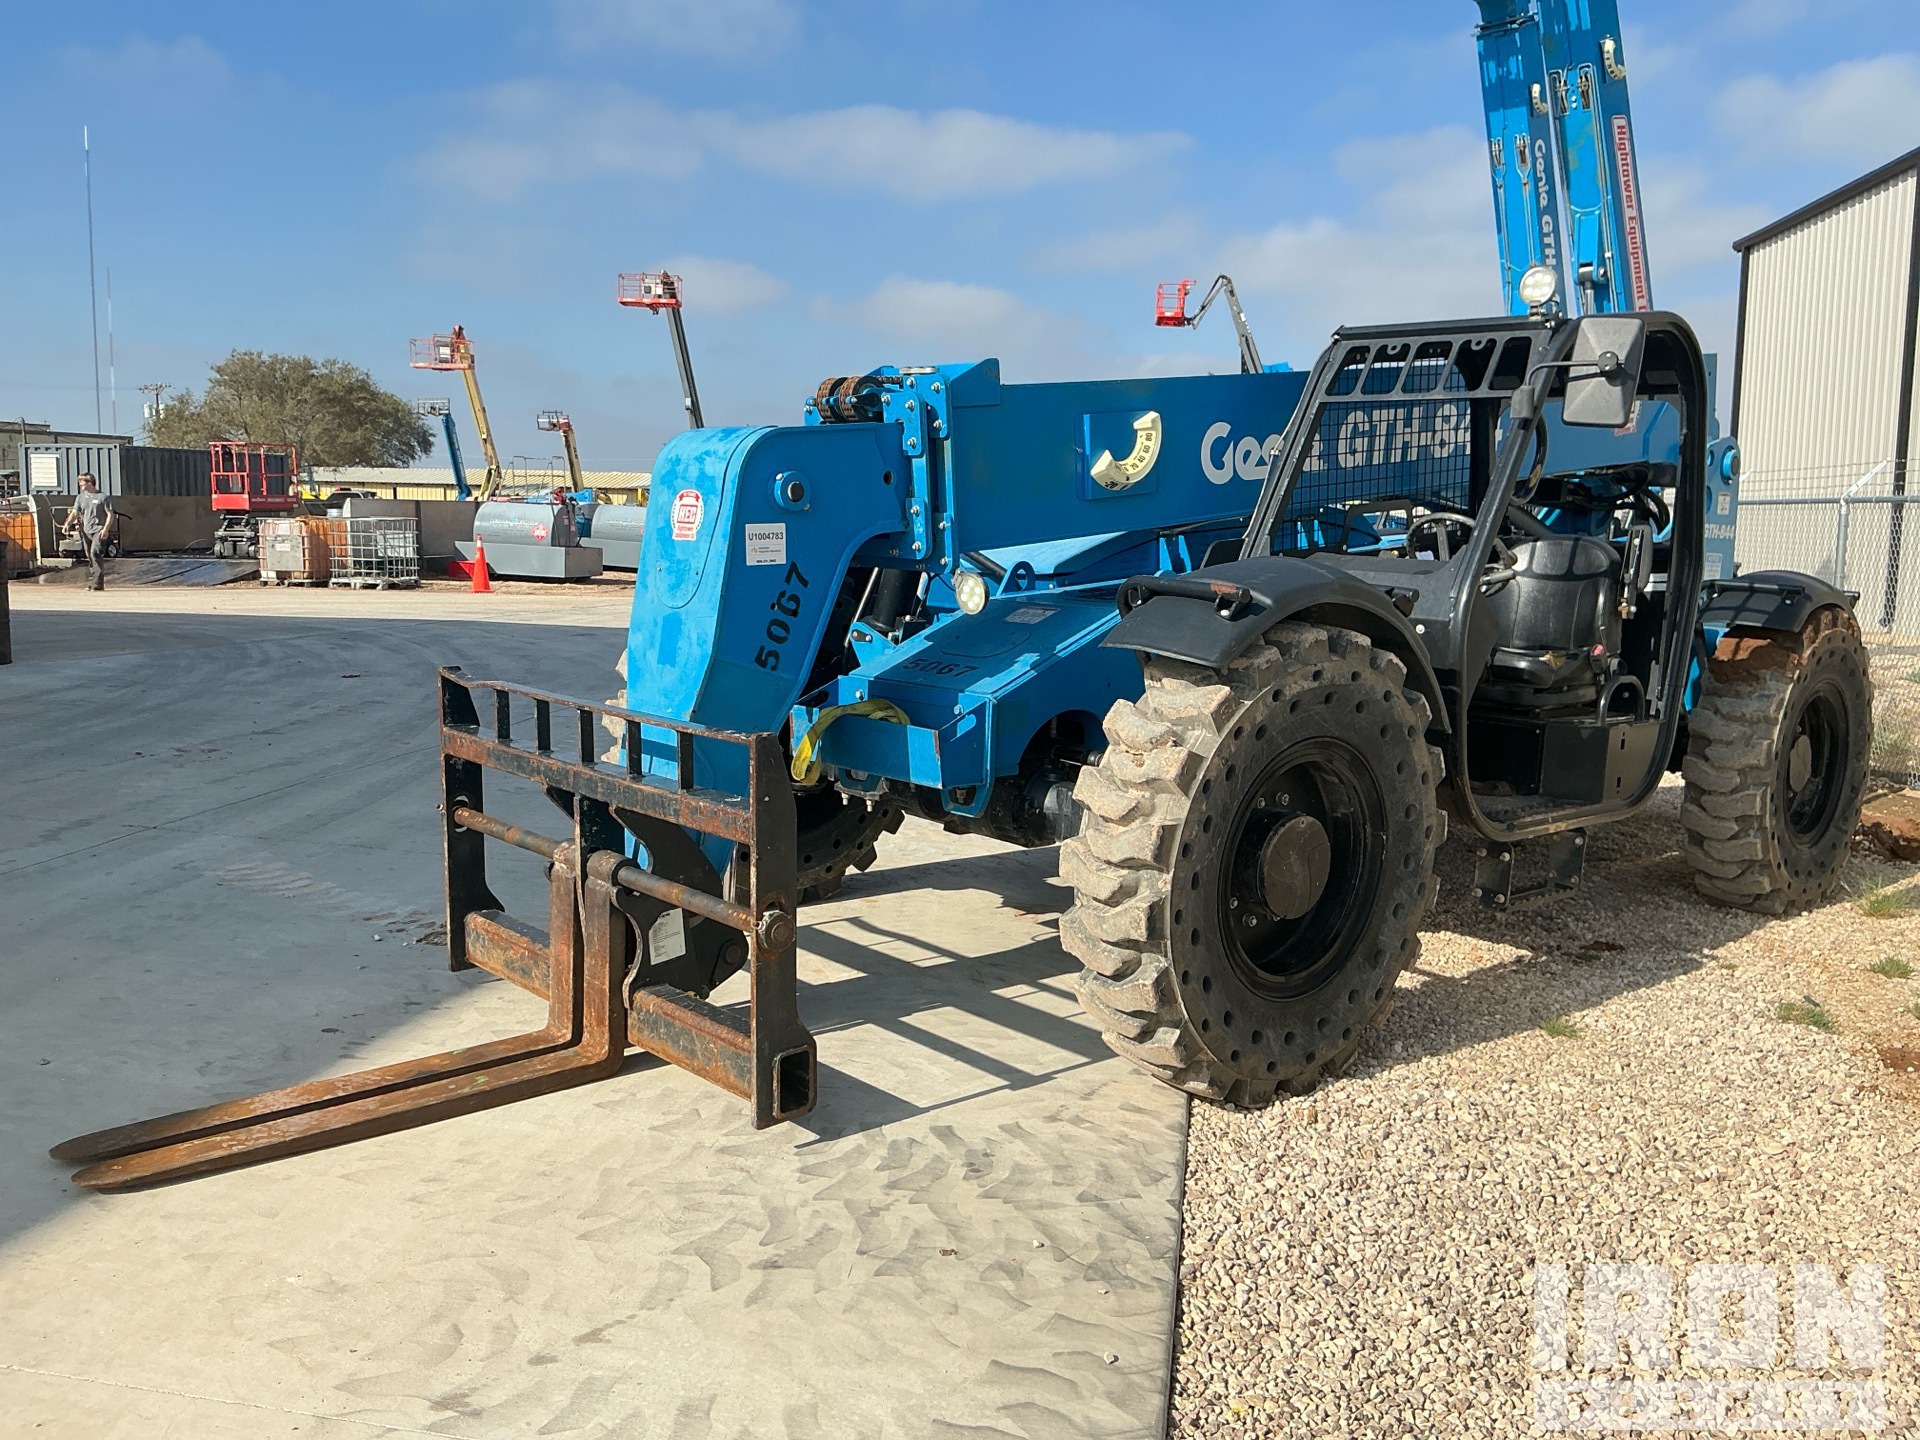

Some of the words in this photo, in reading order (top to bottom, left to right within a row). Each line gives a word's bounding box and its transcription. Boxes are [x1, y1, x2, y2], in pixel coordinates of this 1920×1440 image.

[1534, 138, 1549, 209] Genie
[1616, 125, 1634, 210] Hightower
[1628, 216, 1645, 301] Equipment
[1145, 433, 1153, 441] 80
[1143, 445, 1151, 453] 60
[1138, 455, 1146, 463] 40
[748, 532, 784, 541] U1004783
[754, 560, 810, 673] 5067
[902, 657, 980, 678] 5067
